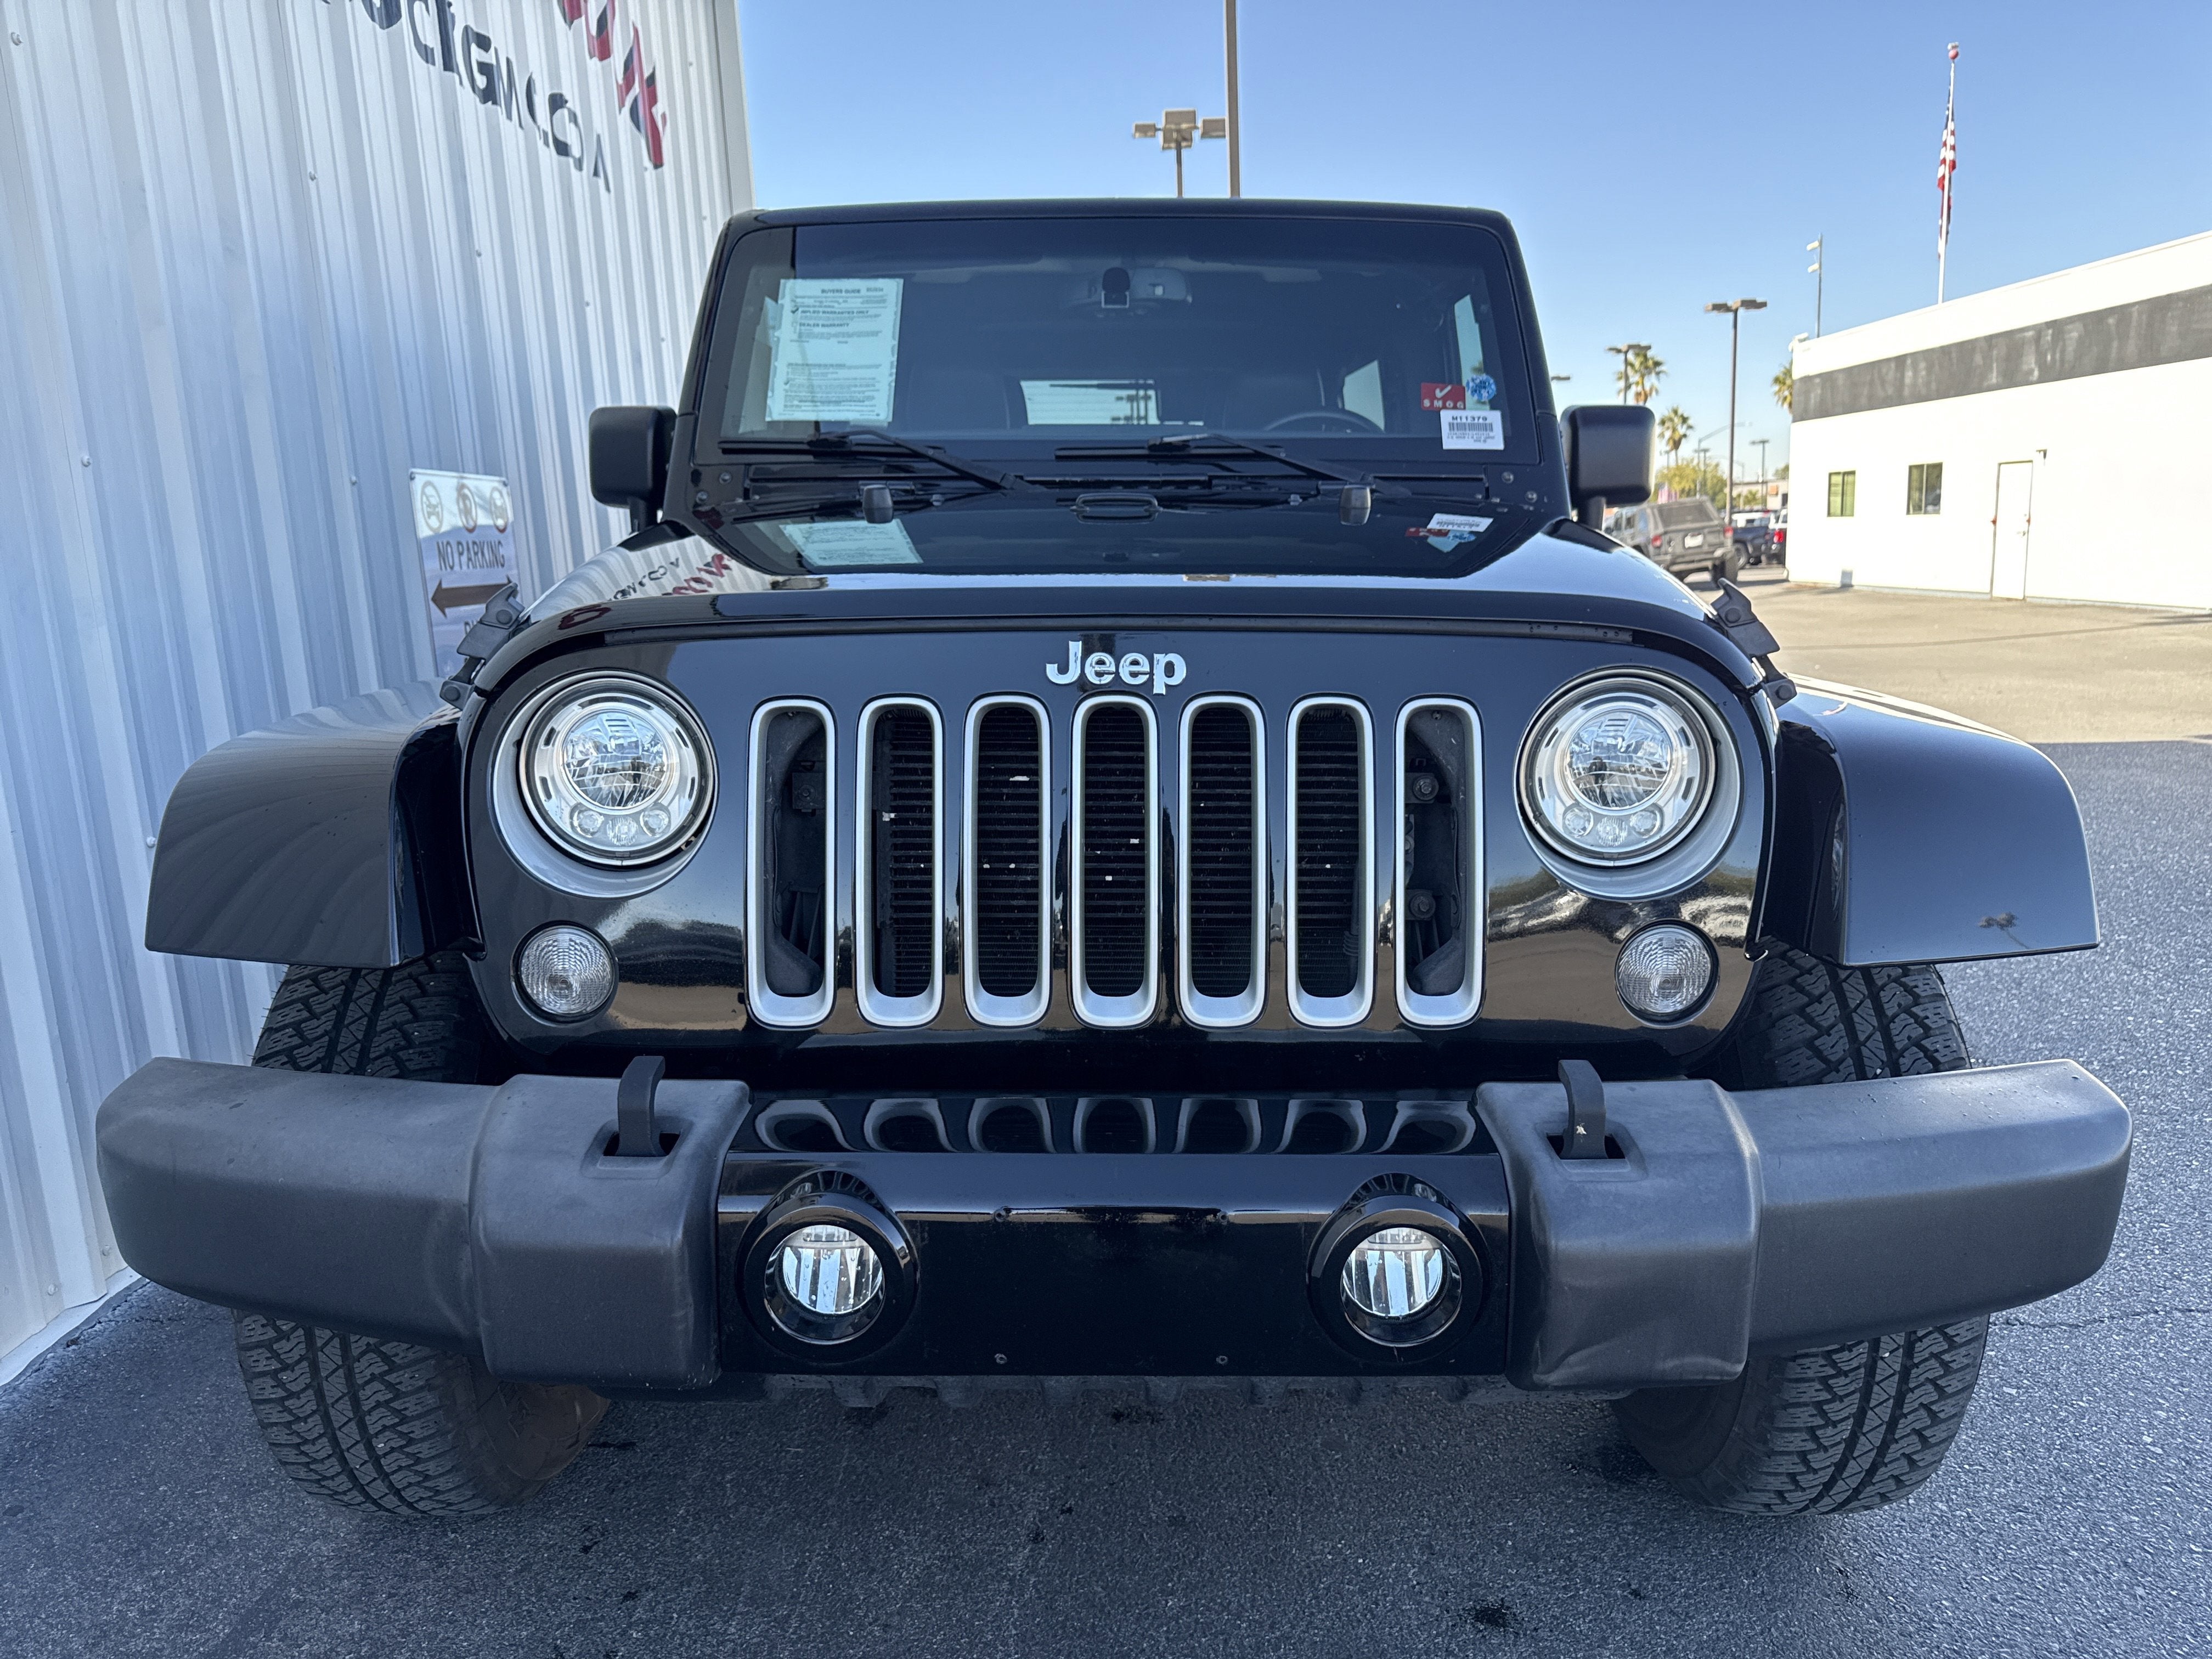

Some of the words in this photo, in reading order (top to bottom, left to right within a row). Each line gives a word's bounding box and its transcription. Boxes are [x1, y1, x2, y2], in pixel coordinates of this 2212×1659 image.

[1423, 399, 1464, 409] SMOG
[436, 540, 454, 571] NO
[456, 539, 505, 570] PARKING
[1046, 640, 1187, 696] Jeep
